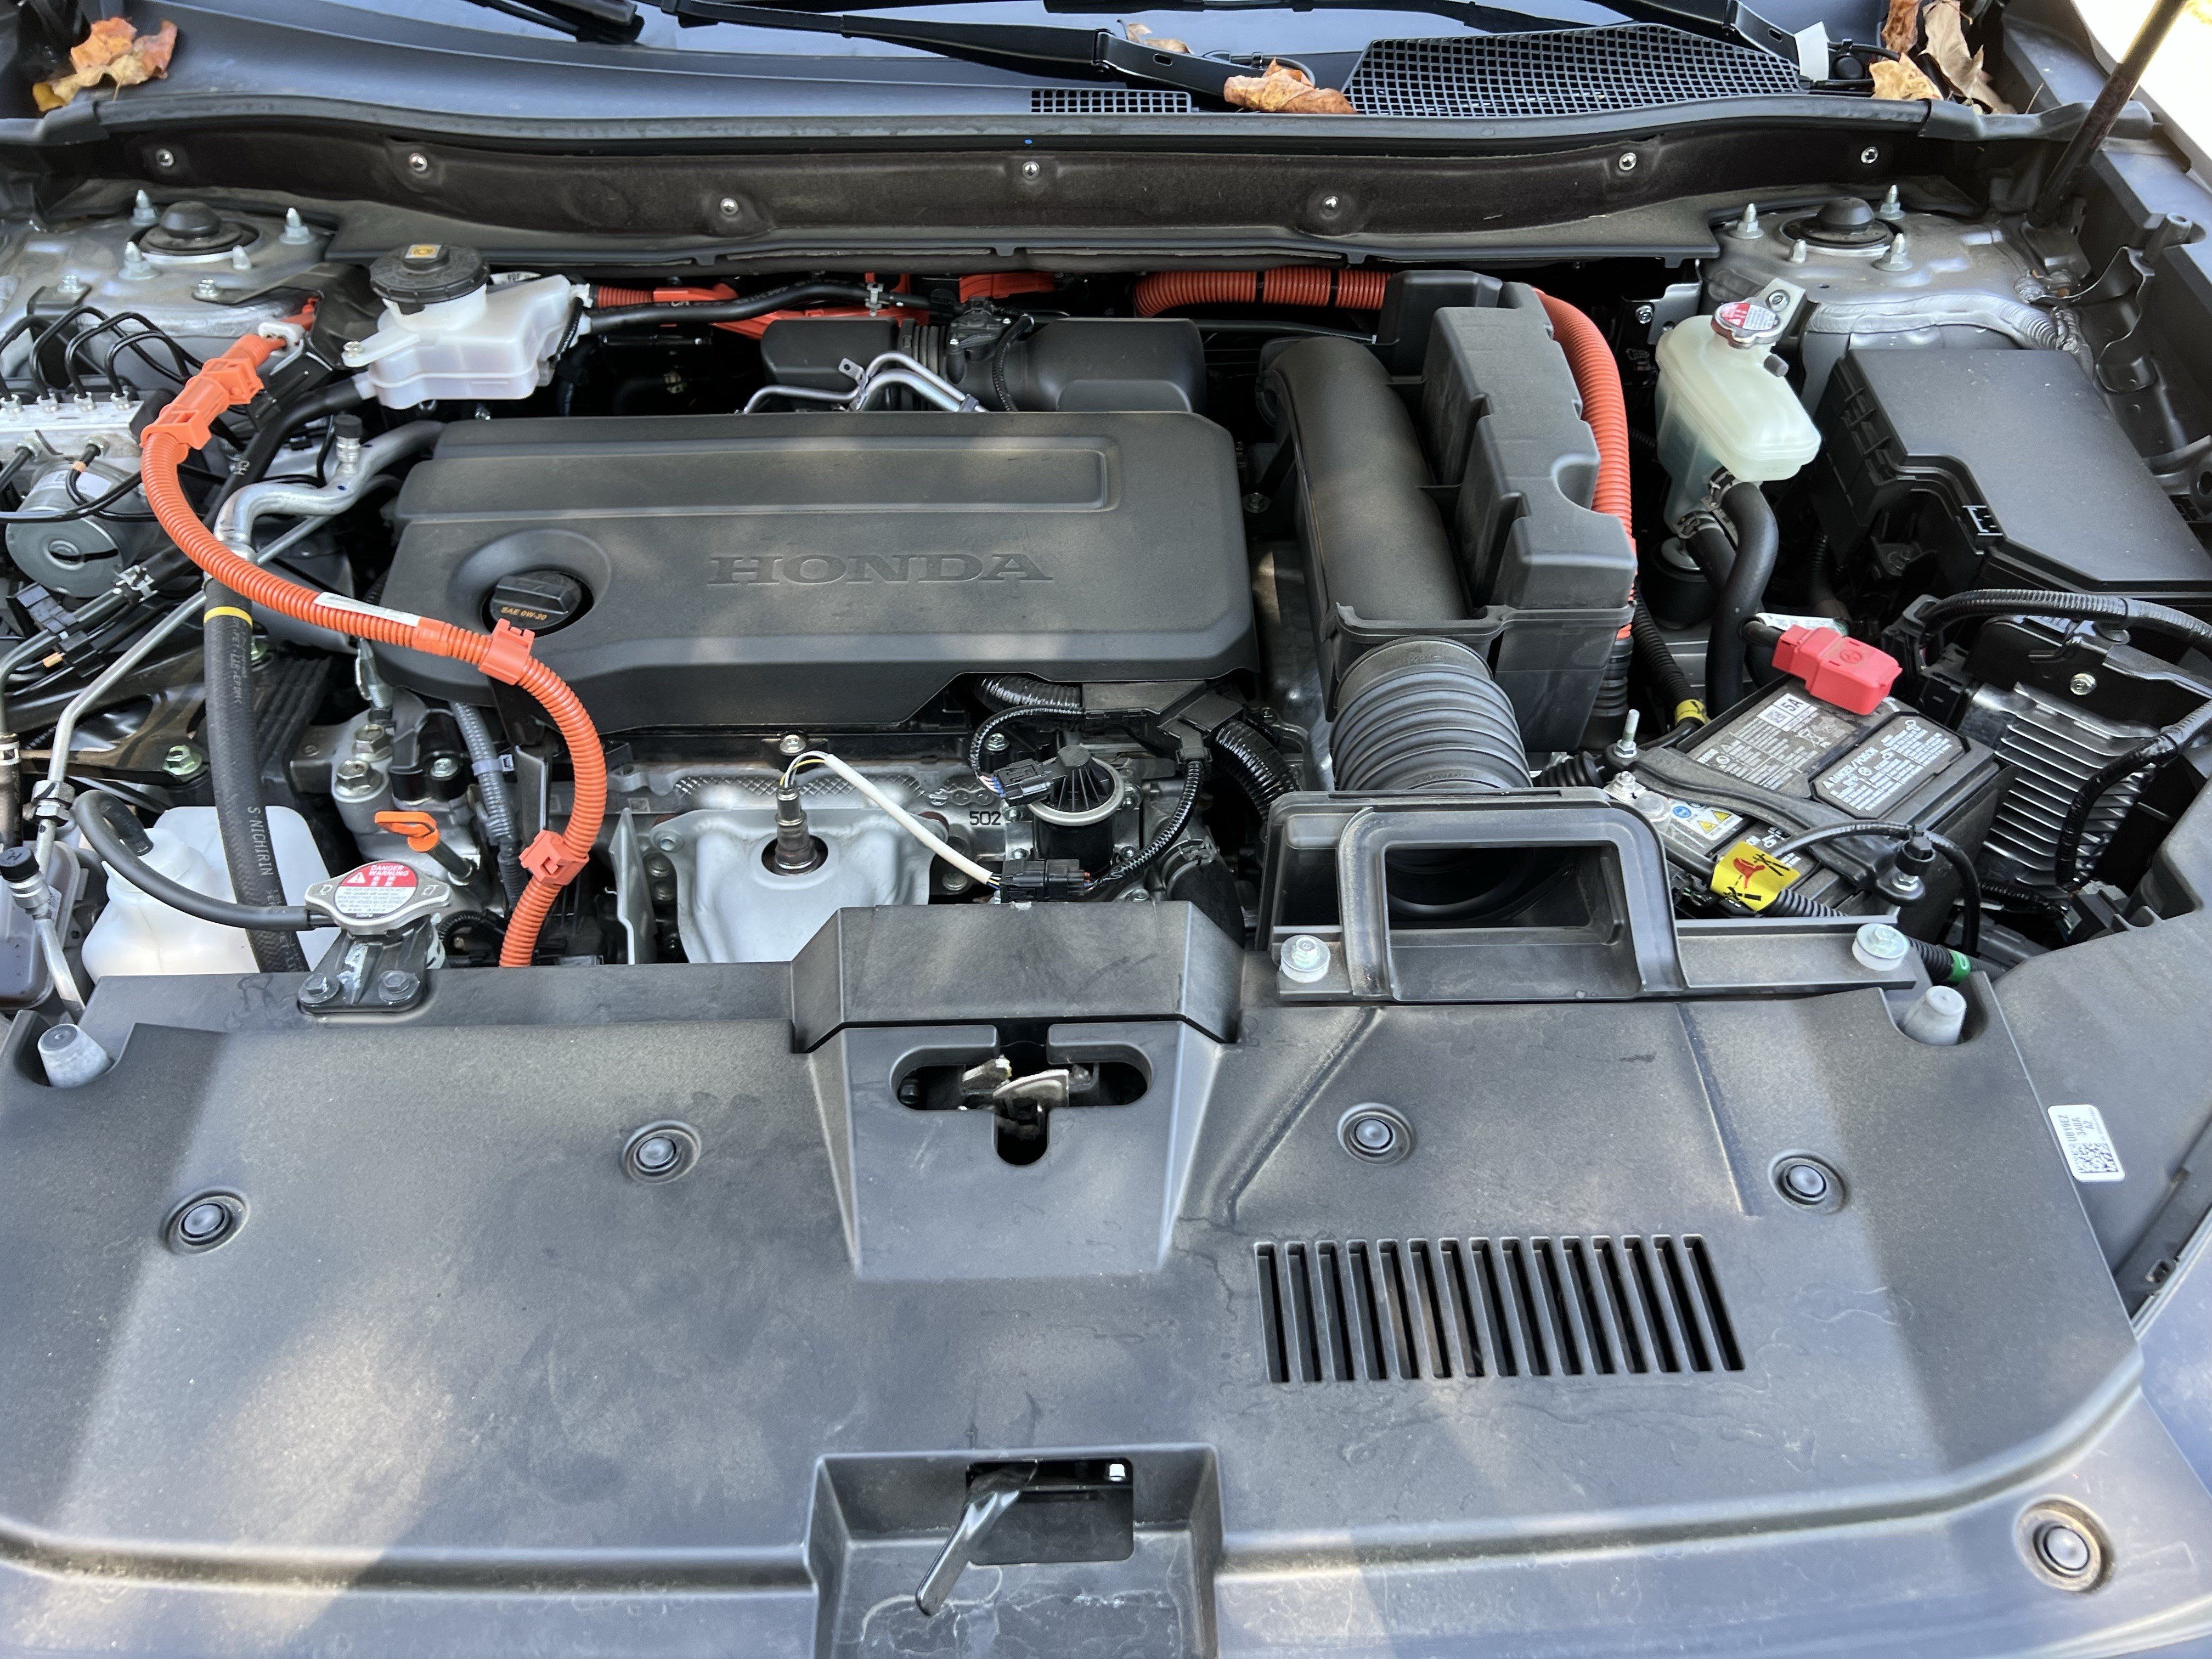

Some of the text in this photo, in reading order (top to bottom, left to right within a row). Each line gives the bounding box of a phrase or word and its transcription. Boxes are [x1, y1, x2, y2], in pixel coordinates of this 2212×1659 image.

[708, 553, 1053, 584] HONDA
[500, 607, 548, 620] SAE 0W-20
[1781, 698, 1803, 711] 5A
[969, 811, 1001, 825] 502
